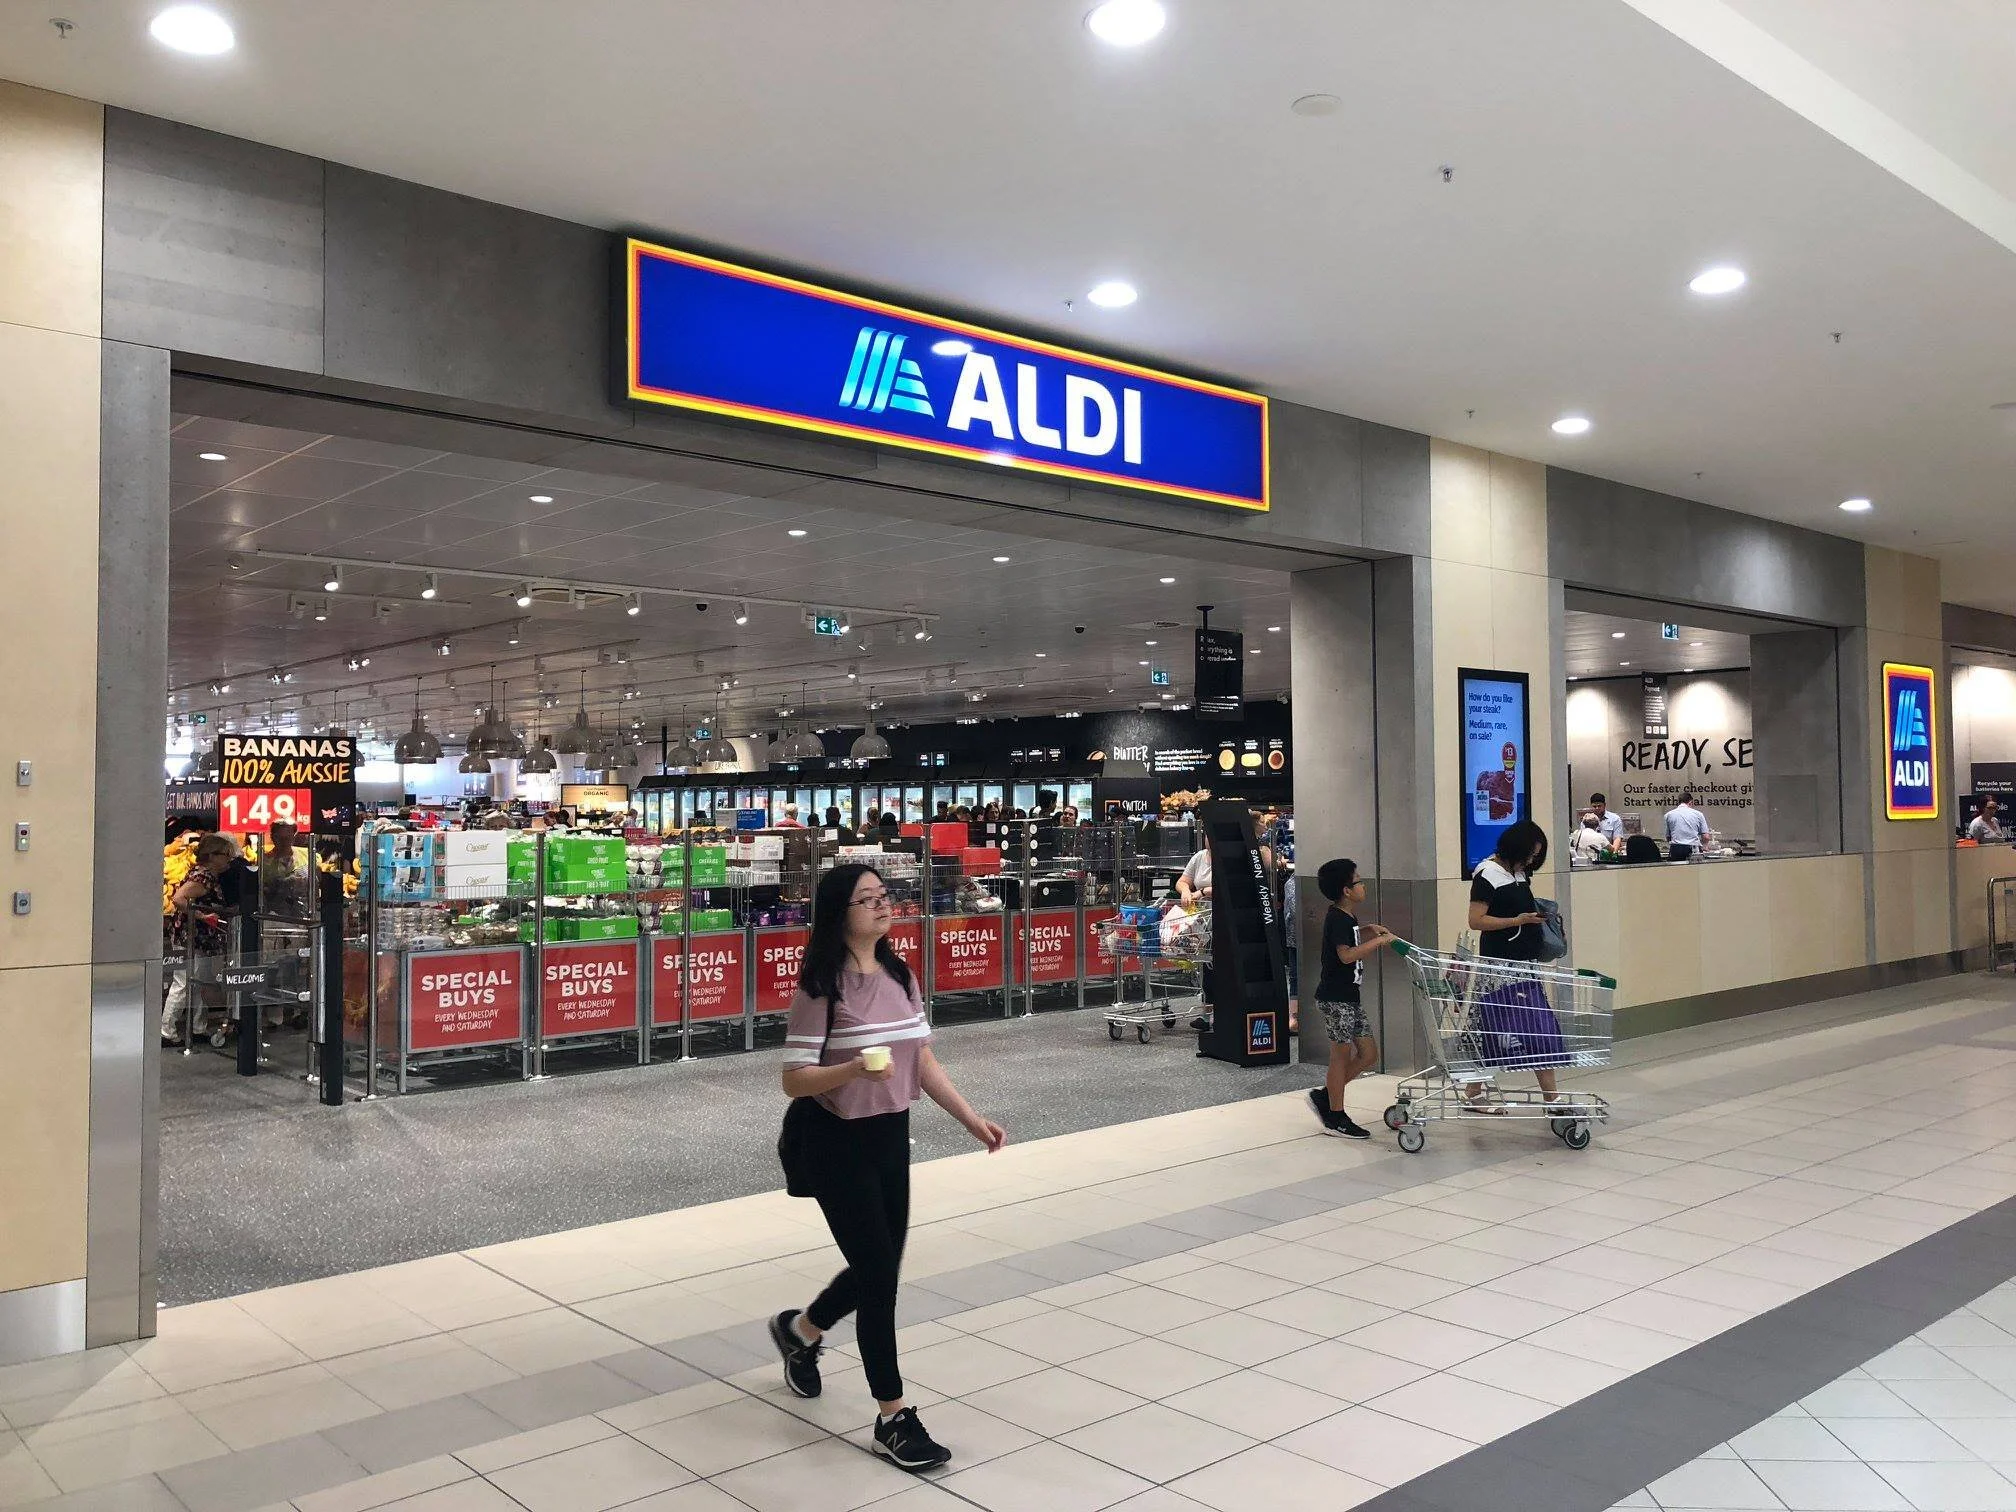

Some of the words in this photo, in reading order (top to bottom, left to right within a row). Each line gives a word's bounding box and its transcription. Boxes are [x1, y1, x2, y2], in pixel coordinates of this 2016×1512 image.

[947, 351, 1142, 465] ALDI
[1469, 693, 1482, 701] How
[1483, 693, 1490, 701] do
[1491, 696, 1502, 704] you
[1469, 706, 1482, 714] your
[1483, 705, 1501, 713] steak?
[1469, 720, 1493, 731] Medium,
[1494, 722, 1508, 730] rare,
[224, 738, 351, 758] BANANAS
[1114, 746, 1149, 761] BUTTER
[1622, 738, 1711, 774] READY,
[1722, 737, 1753, 768] SE
[222, 758, 276, 784] 100%
[279, 760, 351, 784] AUSSIE
[1894, 760, 1929, 787] ALDI
[1623, 784, 1646, 794] Our
[1648, 783, 1680, 794] faster
[1683, 782, 1738, 793] checkout
[1740, 783, 1753, 797] gi
[1122, 800, 1148, 812] SWITCH
[1623, 796, 1652, 807] Start
[1654, 796, 1679, 807] with
[222, 794, 296, 826] 1.49
[297, 813, 311, 825] kg
[1250, 849, 1264, 879] News
[1259, 885, 1274, 925] Weekly
[941, 928, 998, 944] SPECIAL
[763, 945, 805, 963] SPEC
[952, 942, 987, 958] BUYS
[1030, 938, 1062, 954] BUYS
[163, 956, 184, 966] COME
[776, 961, 799, 977] BU
[545, 961, 629, 981] SPECIAL
[226, 974, 266, 985] WELCOME
[421, 970, 512, 991] SPECIAL
[561, 979, 614, 997] BUYS
[692, 986, 728, 997] WEDNESDAY
[438, 988, 496, 1008] BUYS
[557, 1002, 577, 1011] EVERY
[578, 998, 617, 1010] WEDNESDAY
[692, 996, 722, 1007] SATURDAY
[434, 1013, 456, 1023] EVERY
[457, 1009, 499, 1021] WEDNESDAY
[563, 1011, 577, 1021] AND
[577, 1009, 611, 1020] SATURDAY
[441, 1022, 456, 1033] AND
[456, 1020, 493, 1032] SATURDAY
[1252, 1036, 1272, 1047] ALDI
